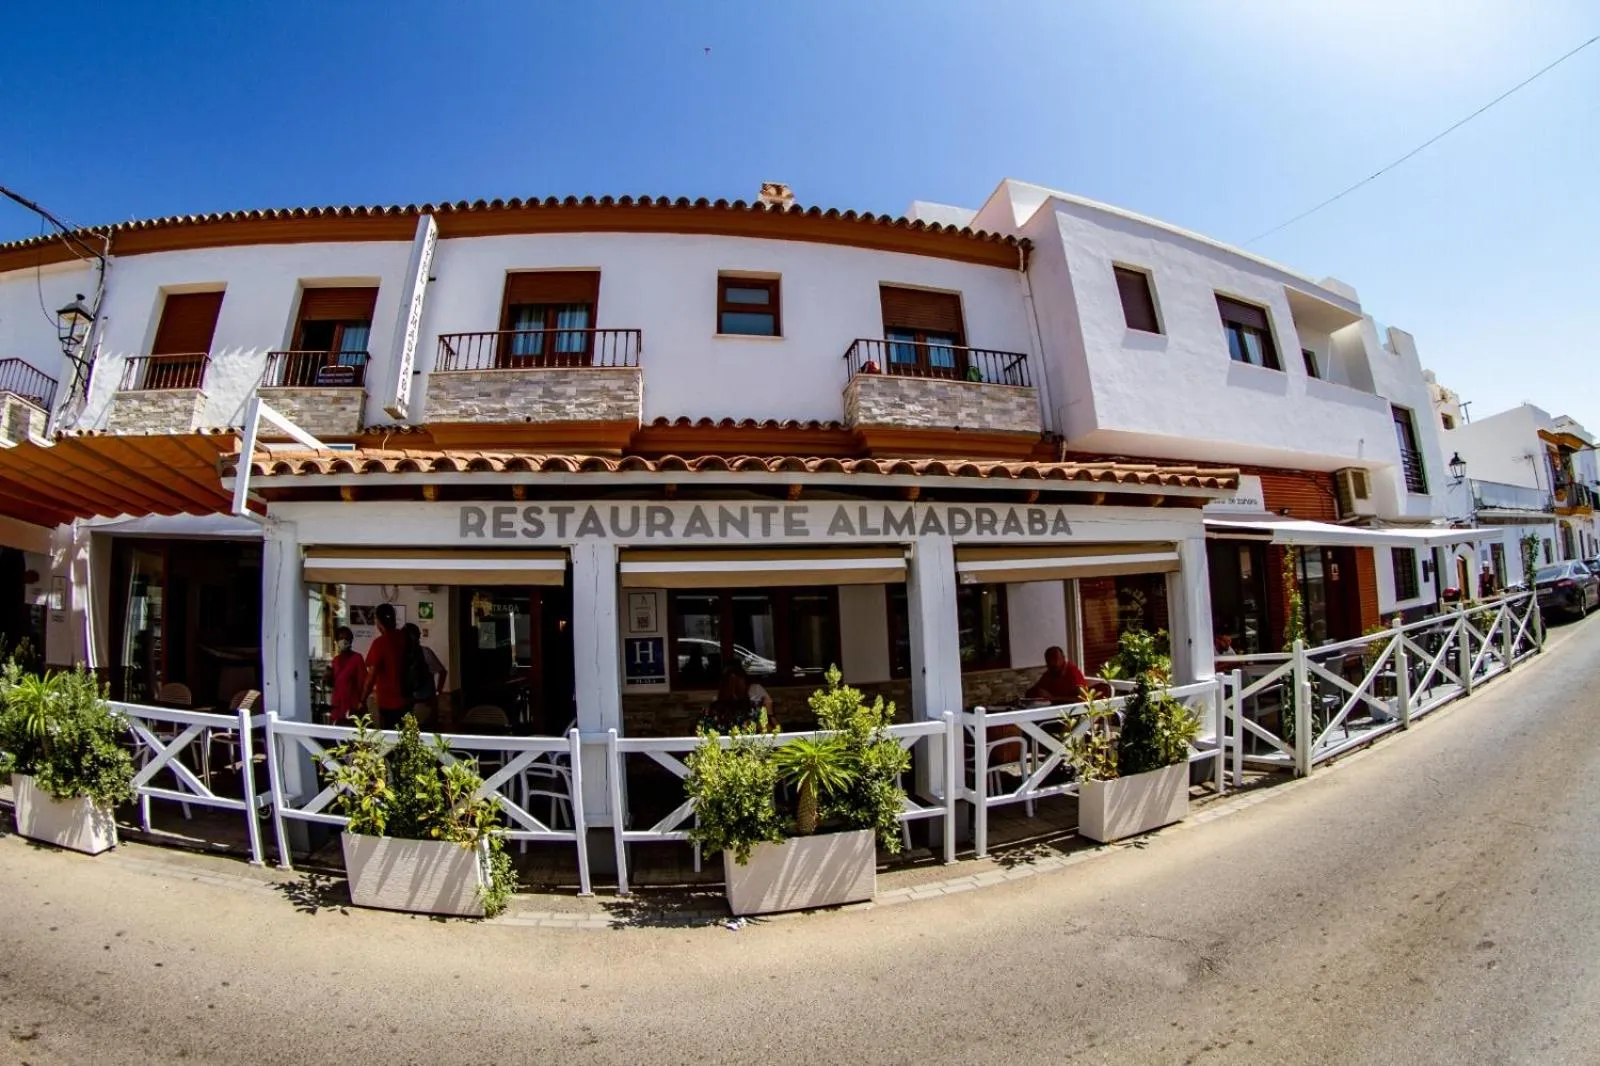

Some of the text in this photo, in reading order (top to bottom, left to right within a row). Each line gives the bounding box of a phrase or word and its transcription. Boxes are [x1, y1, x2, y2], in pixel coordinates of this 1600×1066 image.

[420, 228, 435, 285] HOTEL
[459, 504, 1073, 539] RESTAURANTE ALMADRABA
[634, 641, 655, 664] H
